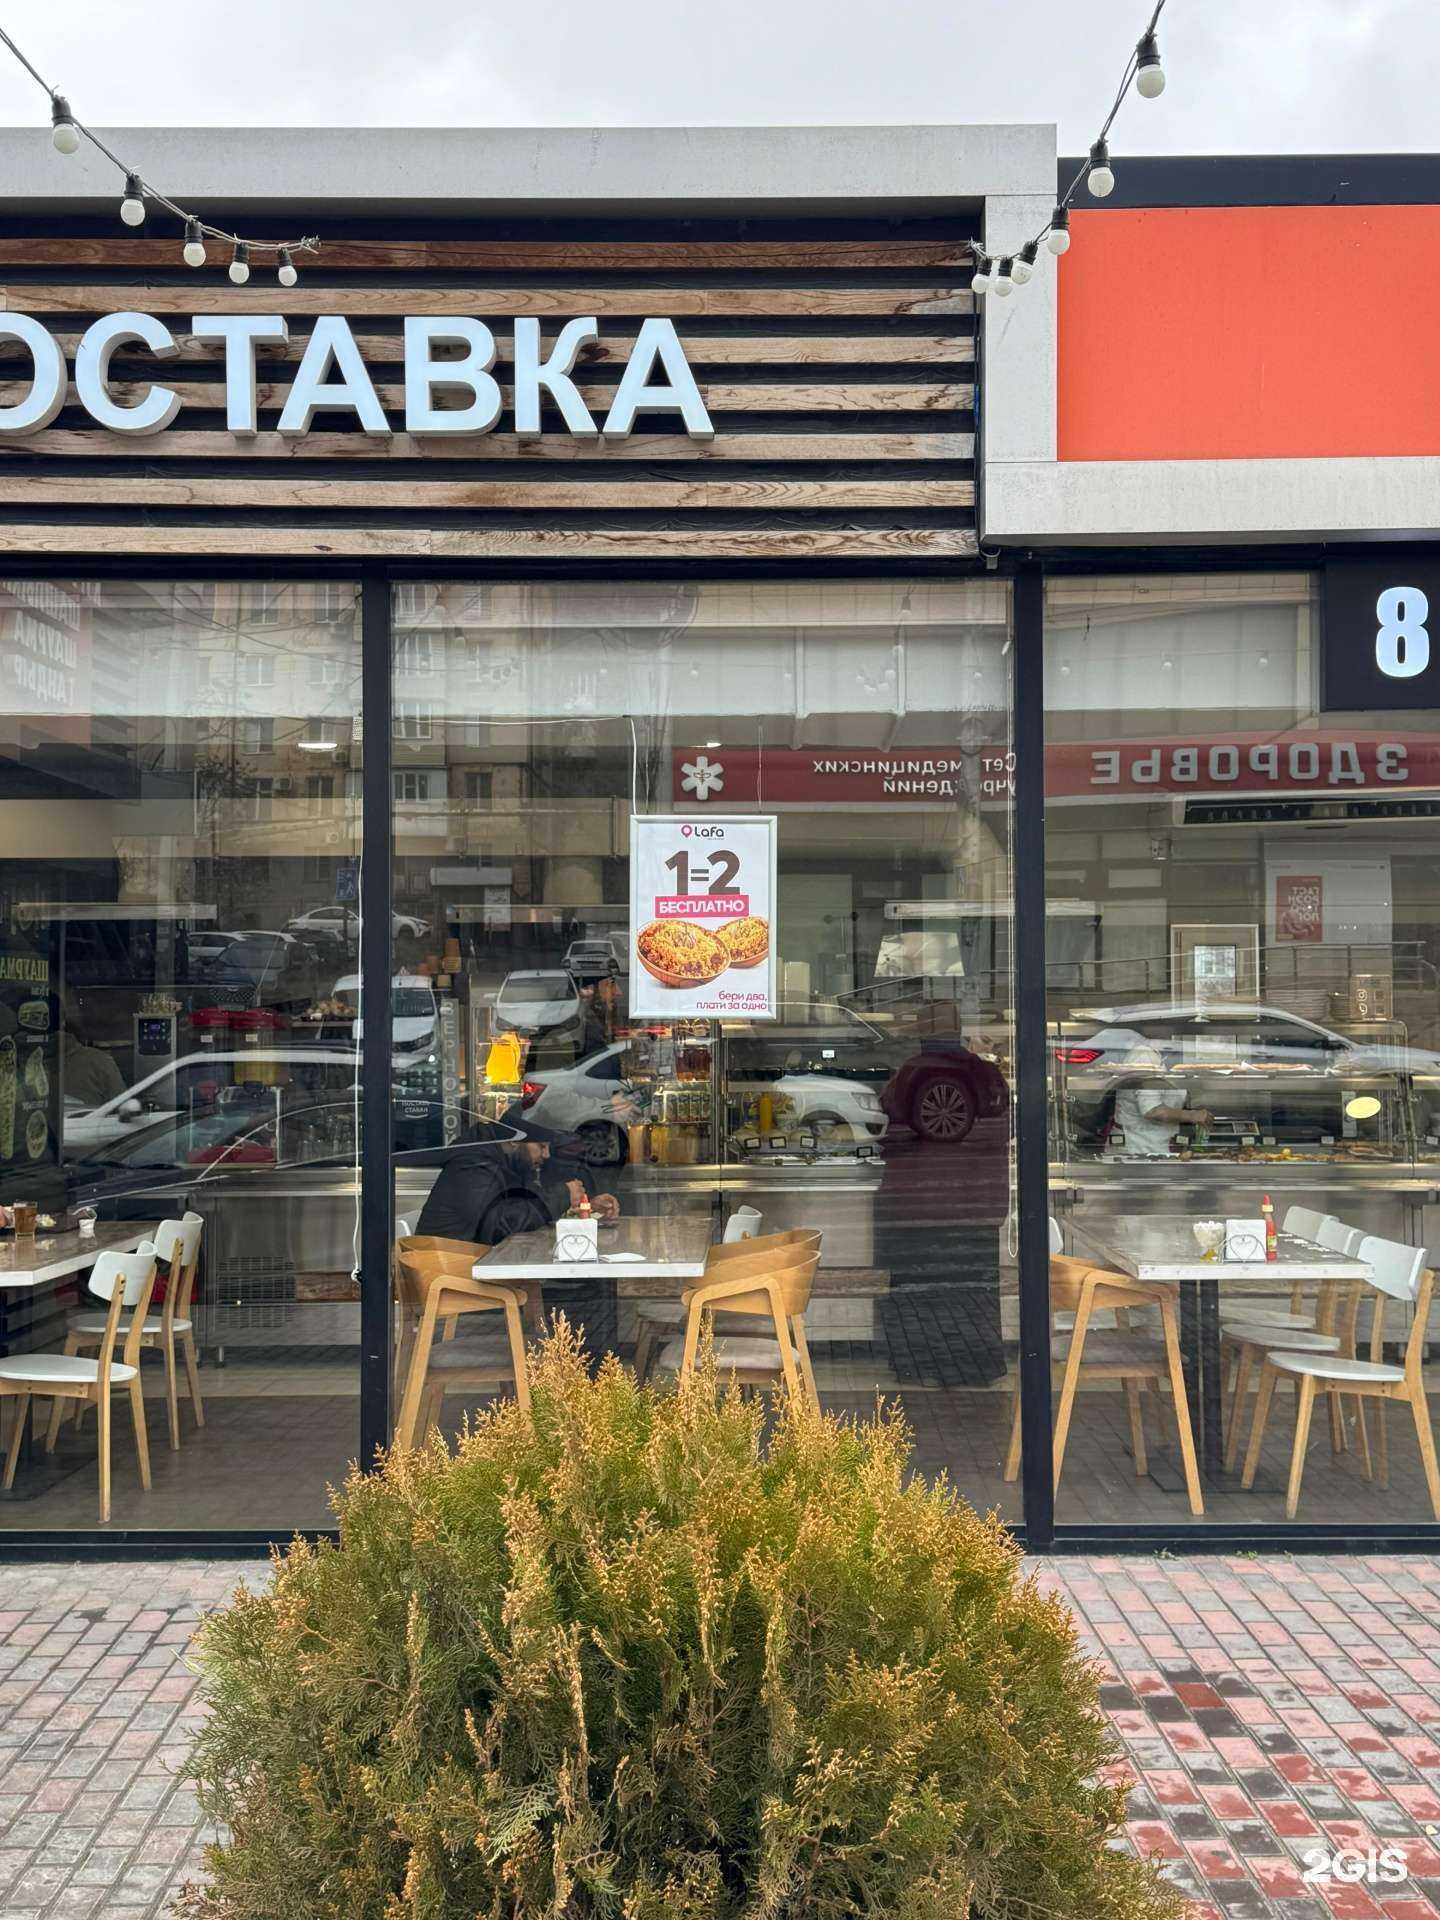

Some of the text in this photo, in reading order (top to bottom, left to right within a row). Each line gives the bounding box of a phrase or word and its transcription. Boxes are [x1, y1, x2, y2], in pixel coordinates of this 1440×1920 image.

[1376, 586, 1430, 678] 8
[694, 826, 725, 838] Lafa
[665, 849, 741, 895] 1=2
[658, 899, 746, 914] БЕСПЛАТНО
[718, 990, 768, 1003] бери два,
[696, 1001, 768, 1011] плати за одно
